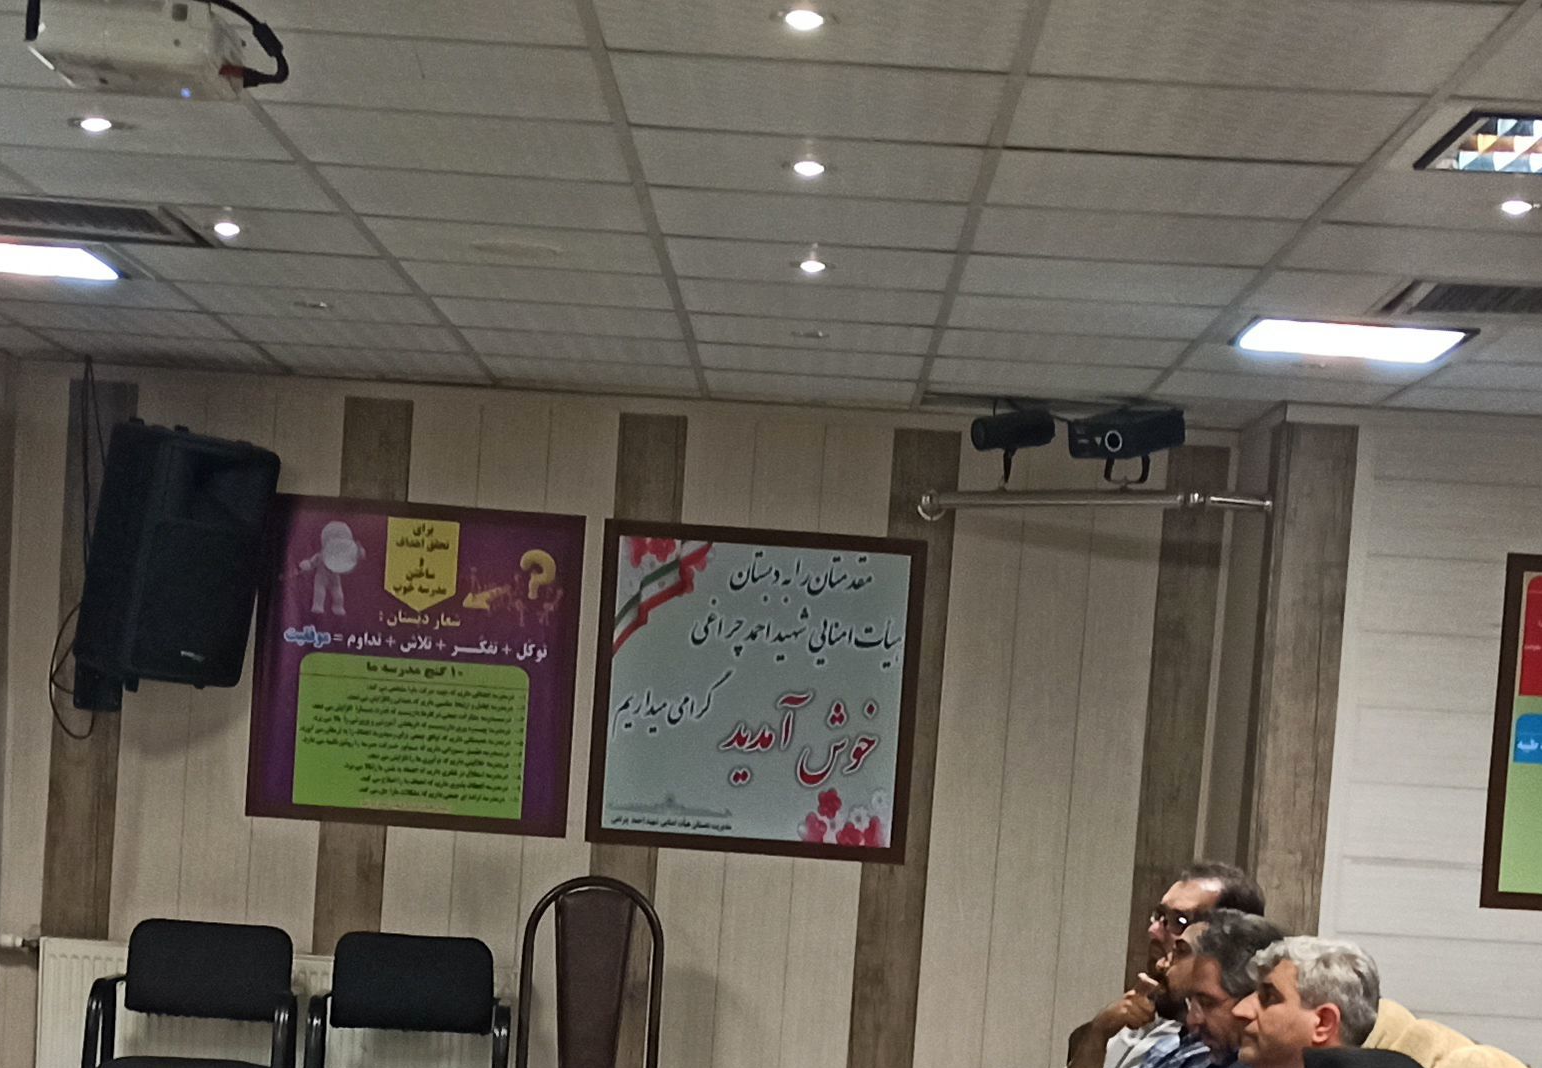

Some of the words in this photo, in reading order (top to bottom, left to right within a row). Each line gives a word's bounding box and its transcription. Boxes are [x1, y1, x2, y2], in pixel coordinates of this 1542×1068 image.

[729, 551, 780, 602] دبستان
[690, 598, 744, 657] چراغی
[744, 620, 771, 641] احمد
[770, 607, 809, 661] شهید
[719, 691, 812, 786] آمدید
[796, 701, 879, 788] خوش
